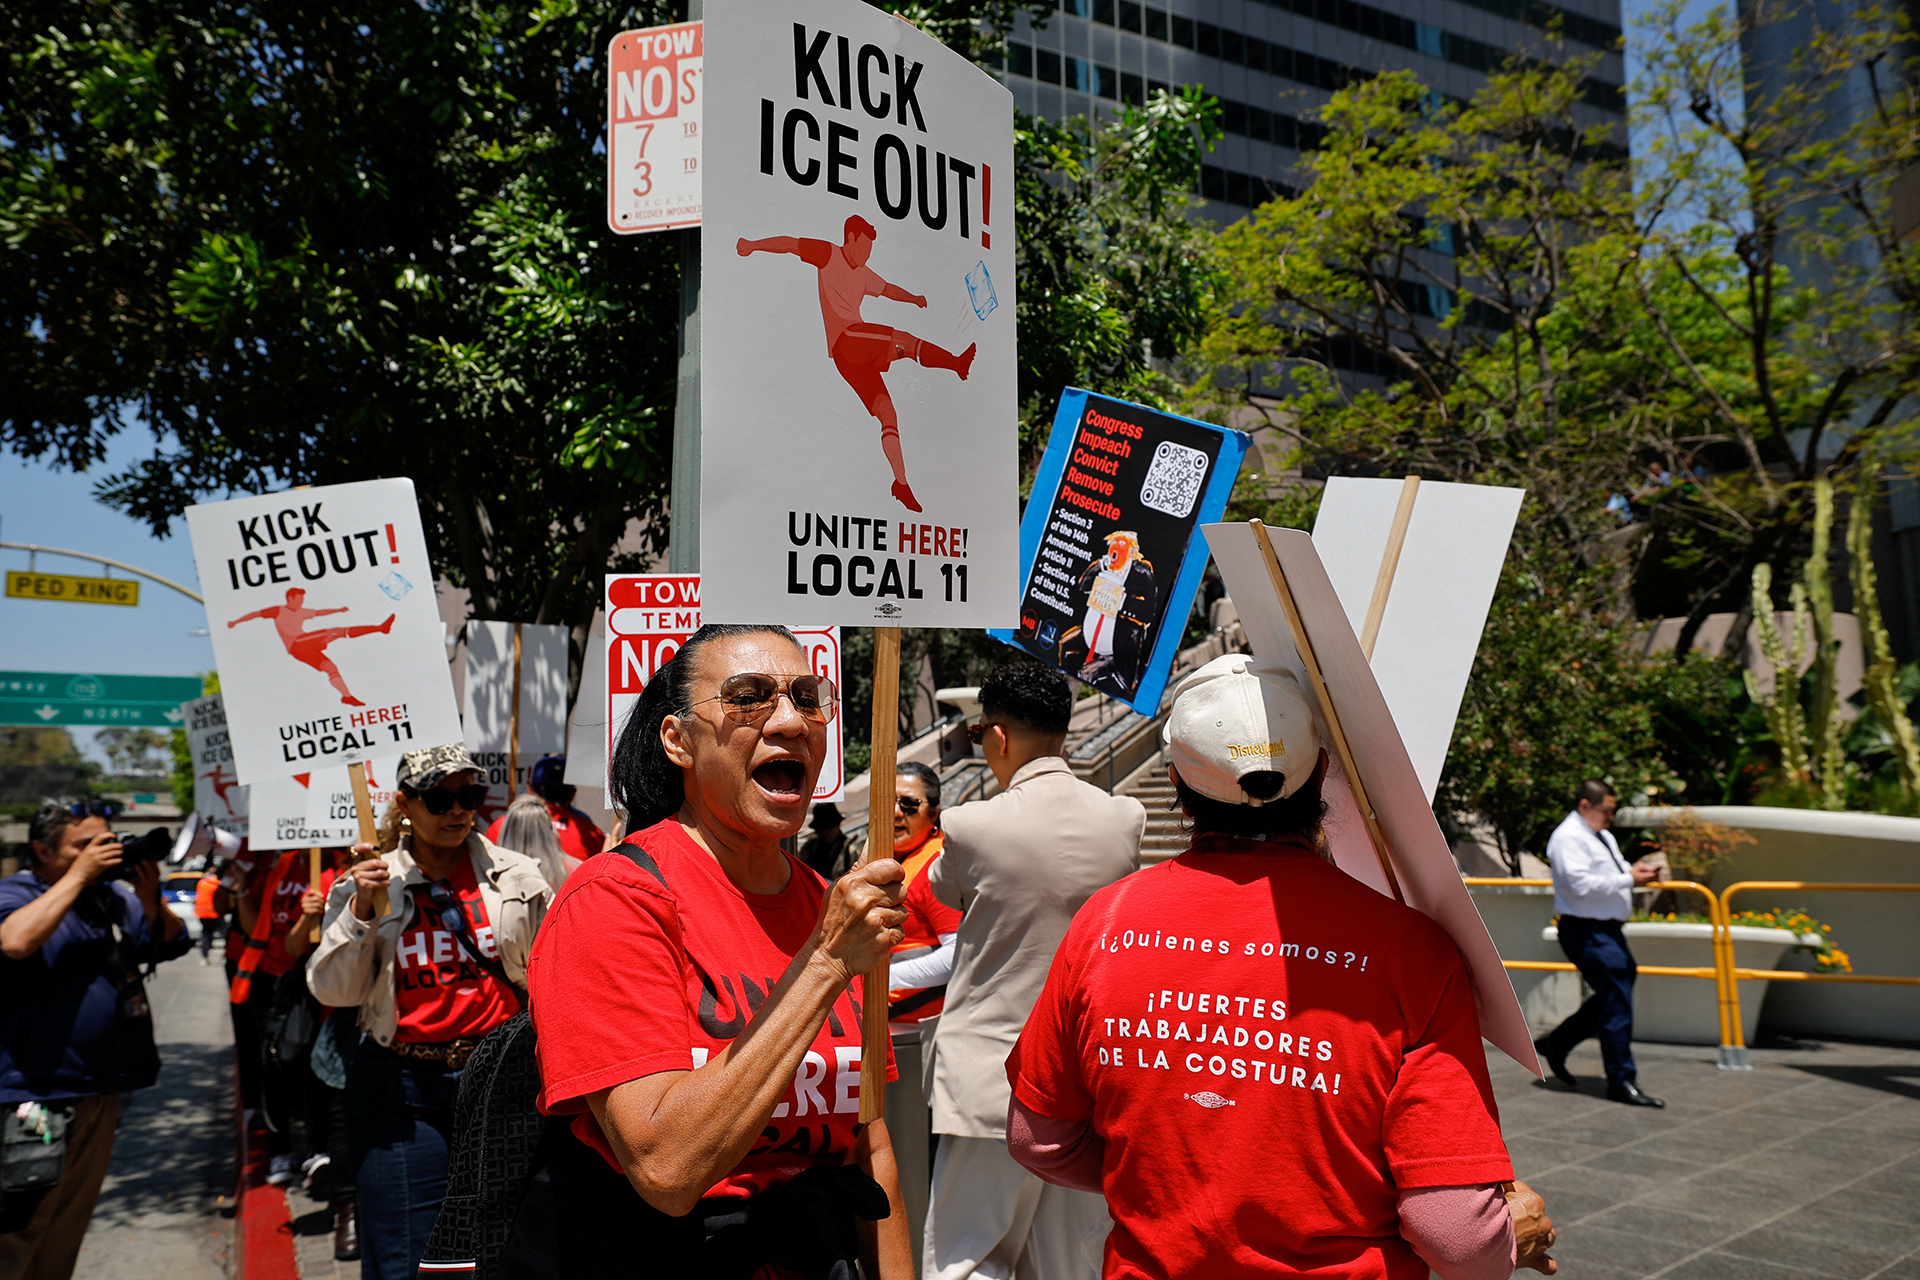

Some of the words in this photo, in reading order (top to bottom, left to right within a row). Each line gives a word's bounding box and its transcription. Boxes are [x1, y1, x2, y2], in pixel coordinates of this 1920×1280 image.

[637, 29, 696, 61] TOW
[617, 65, 672, 119] NO
[792, 22, 927, 133] KICK
[635, 123, 654, 159] 7
[683, 122, 697, 134] TO
[633, 161, 652, 197] 3
[683, 157, 697, 170] TO
[760, 97, 859, 201] ICE
[873, 132, 991, 250] OUT!
[634, 195, 693, 208] EXCEPT
[635, 208, 663, 220] RECOVER
[1085, 409, 1144, 440] Congress
[1079, 428, 1132, 458] Impeach
[1073, 447, 1120, 476] Convict
[1066, 466, 1115, 496] Remove
[1060, 485, 1121, 521] Prosecute
[237, 502, 331, 550] KICK
[1050, 521, 1059, 531] of
[1059, 524, 1073, 537] the
[1072, 528, 1089, 545] 14th
[1058, 508, 1086, 528] Section
[1086, 519, 1094, 530] 3
[788, 511, 888, 551] UNITE
[899, 521, 968, 559] HERE!
[1045, 533, 1093, 562] Amendment
[227, 551, 291, 590] ICE
[296, 523, 400, 581] OUT!
[1041, 547, 1067, 565] Article
[16, 576, 65, 596] PED
[75, 581, 129, 601] XING
[787, 550, 923, 599] LOCAL
[940, 563, 968, 602] 11
[1034, 575, 1043, 585] of
[1042, 577, 1056, 591] the
[1056, 583, 1070, 599] U.S.
[1041, 562, 1070, 583] Section
[1069, 575, 1076, 586] 4
[634, 582, 701, 604] TOW
[1030, 587, 1075, 617] Constitution
[279, 716, 343, 740] UNITE
[350, 703, 408, 728] HERE!
[283, 728, 376, 762] LOCAL
[388, 721, 413, 743] 11
[1226, 738, 1286, 760] Disneyland
[277, 828, 330, 840] LOCAL
[1243, 942, 1369, 972] somos?!
[1147, 990, 1287, 1021] ¡FUERTES
[1104, 1018, 1334, 1061] TRABAJADORES
[1099, 1047, 1124, 1067] DE
[1138, 1048, 1170, 1070] LA
[1185, 1052, 1341, 1096] COSTURA!
